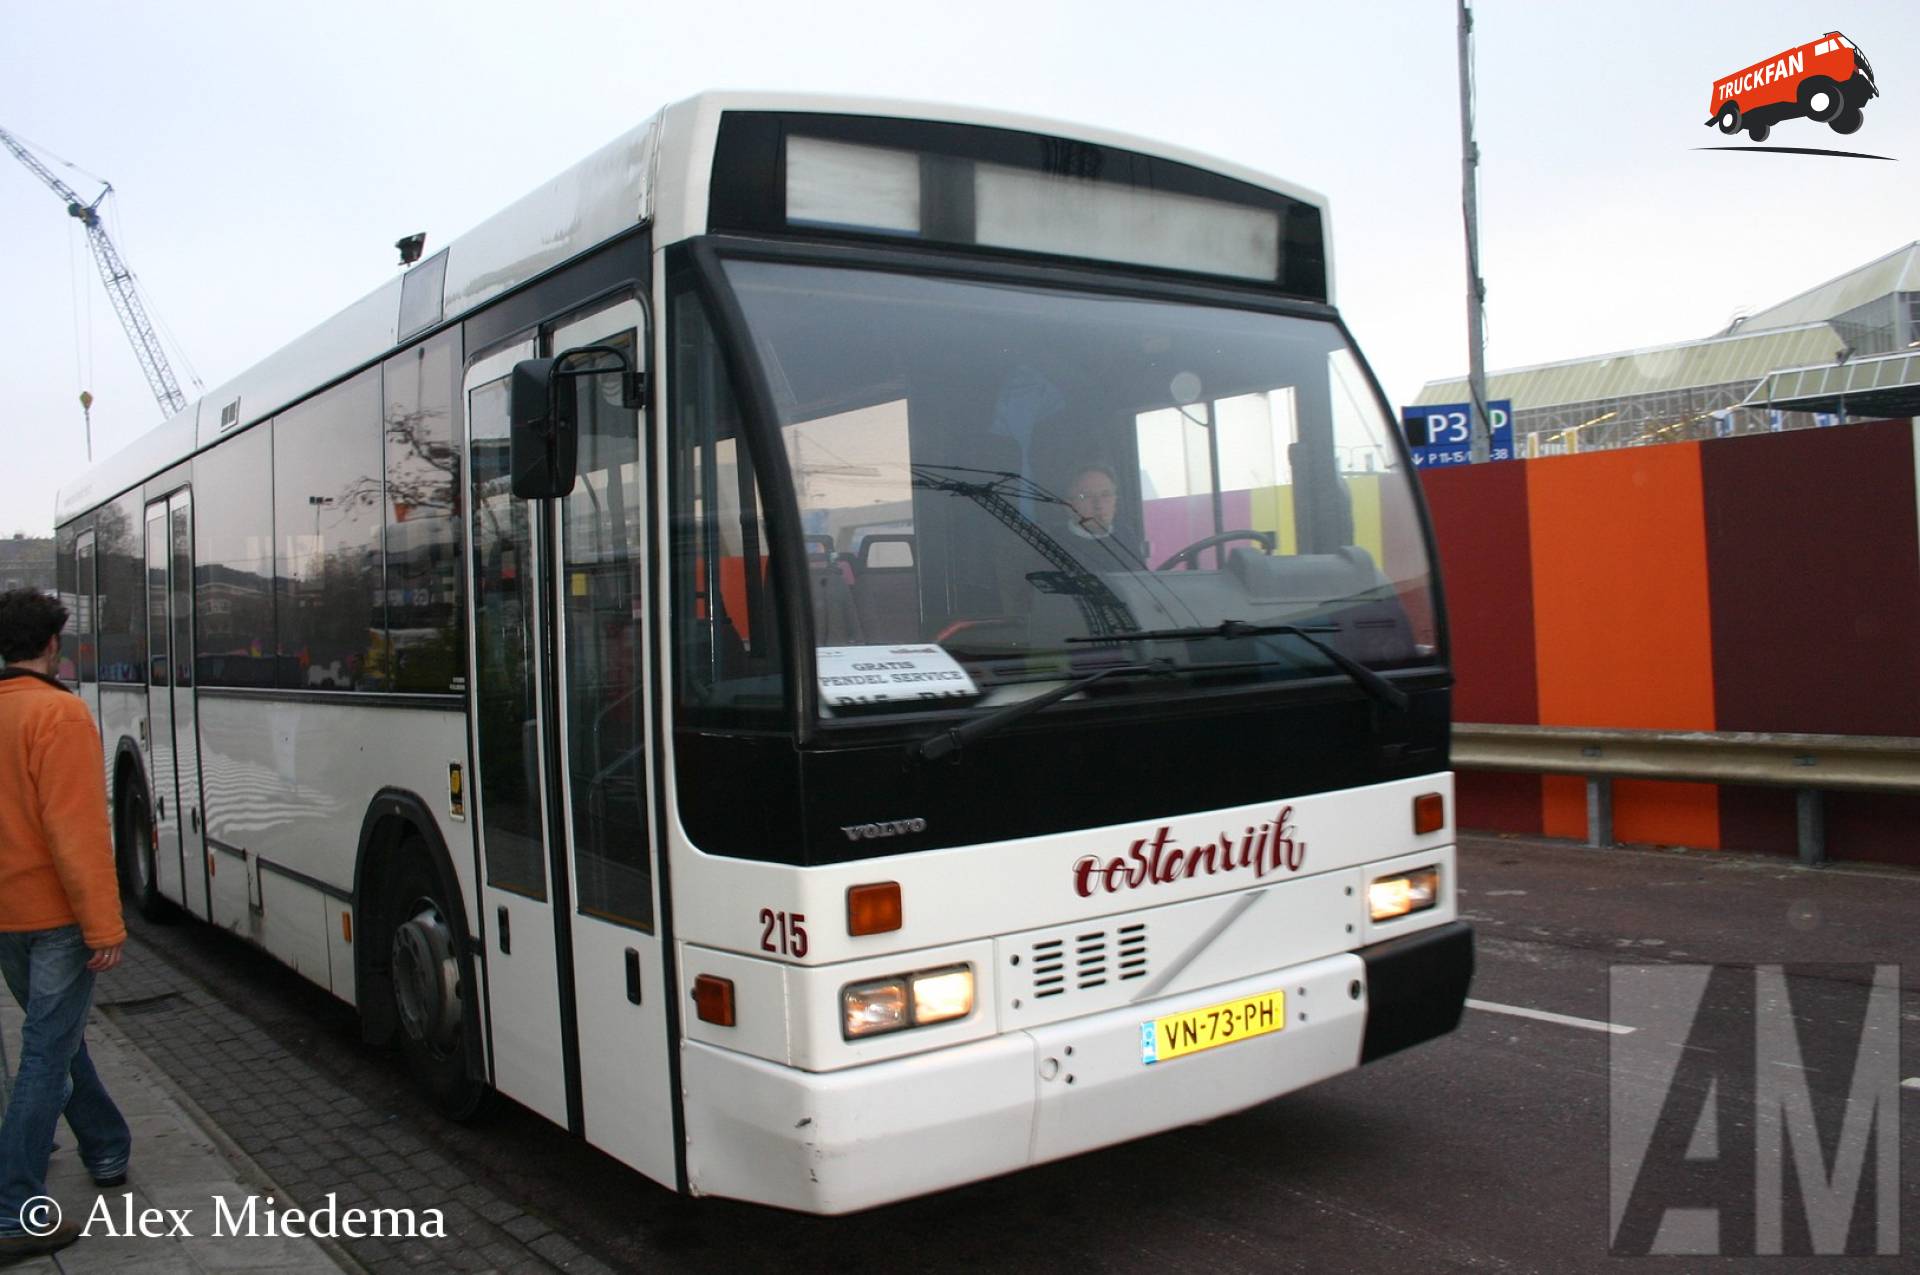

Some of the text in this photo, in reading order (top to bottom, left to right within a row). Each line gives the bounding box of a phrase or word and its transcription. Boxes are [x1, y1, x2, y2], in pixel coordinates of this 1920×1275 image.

[1427, 412, 1468, 443] P3
[1428, 453, 1436, 464] P
[851, 661, 916, 671] GRATIS
[820, 671, 963, 687] PENDEL SERVICE
[840, 817, 927, 841] VOLVO
[759, 907, 808, 958] 215
[1164, 999, 1274, 1050] VN-73-PH
